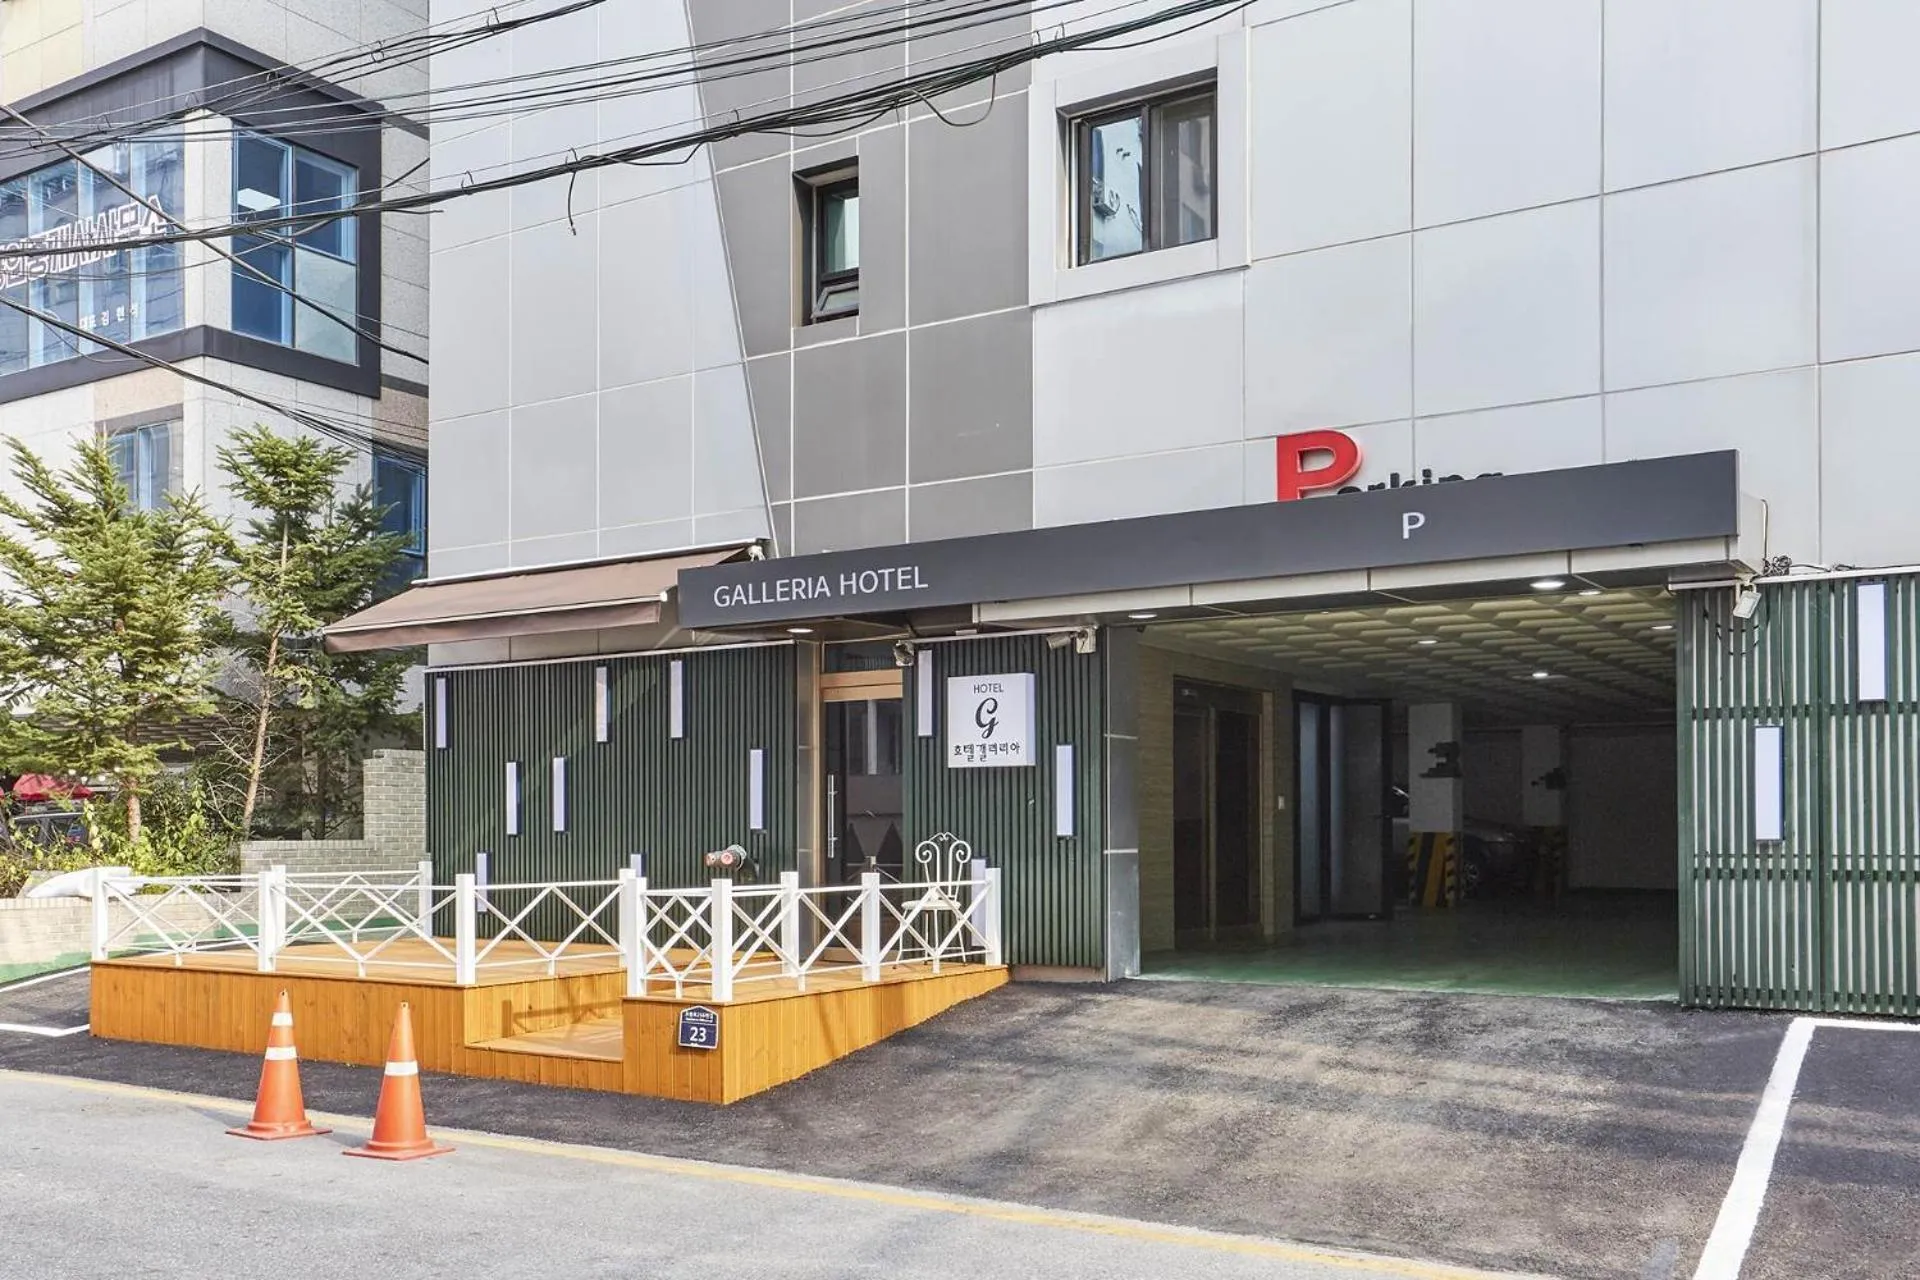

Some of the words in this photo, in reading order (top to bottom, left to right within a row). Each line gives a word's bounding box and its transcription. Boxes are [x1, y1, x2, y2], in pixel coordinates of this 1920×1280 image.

[1402, 512, 1426, 539] P
[713, 575, 831, 608] GALLERIA
[839, 566, 929, 597] HOTEL
[973, 682, 1004, 695] HOTEL
[689, 1026, 707, 1043] 23
